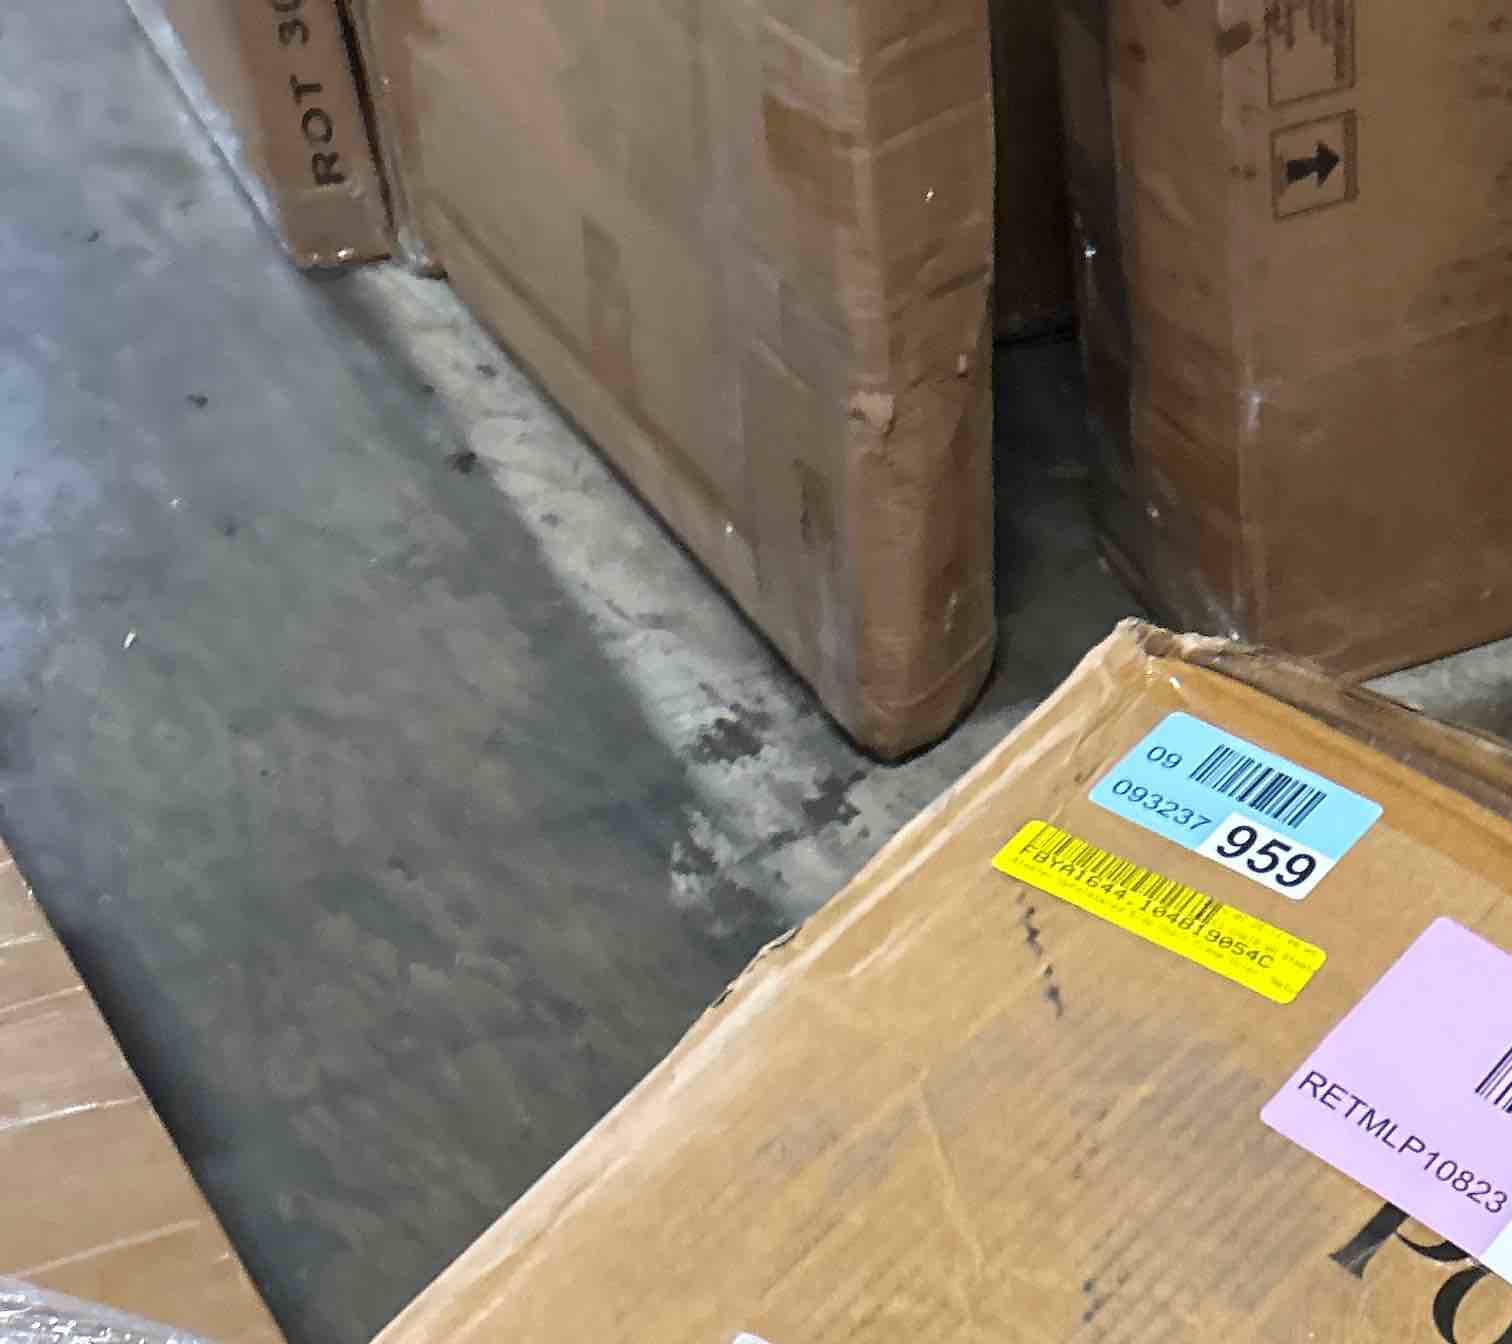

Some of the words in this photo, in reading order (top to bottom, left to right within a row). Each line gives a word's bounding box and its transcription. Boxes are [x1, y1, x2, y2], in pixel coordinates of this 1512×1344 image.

[290, 74, 345, 186] ROT
[1146, 746, 1183, 770] 09
[1111, 779, 1212, 831] 093237
[1216, 825, 1317, 888] 959
[1299, 1070, 1509, 1215] RETMLP10823
